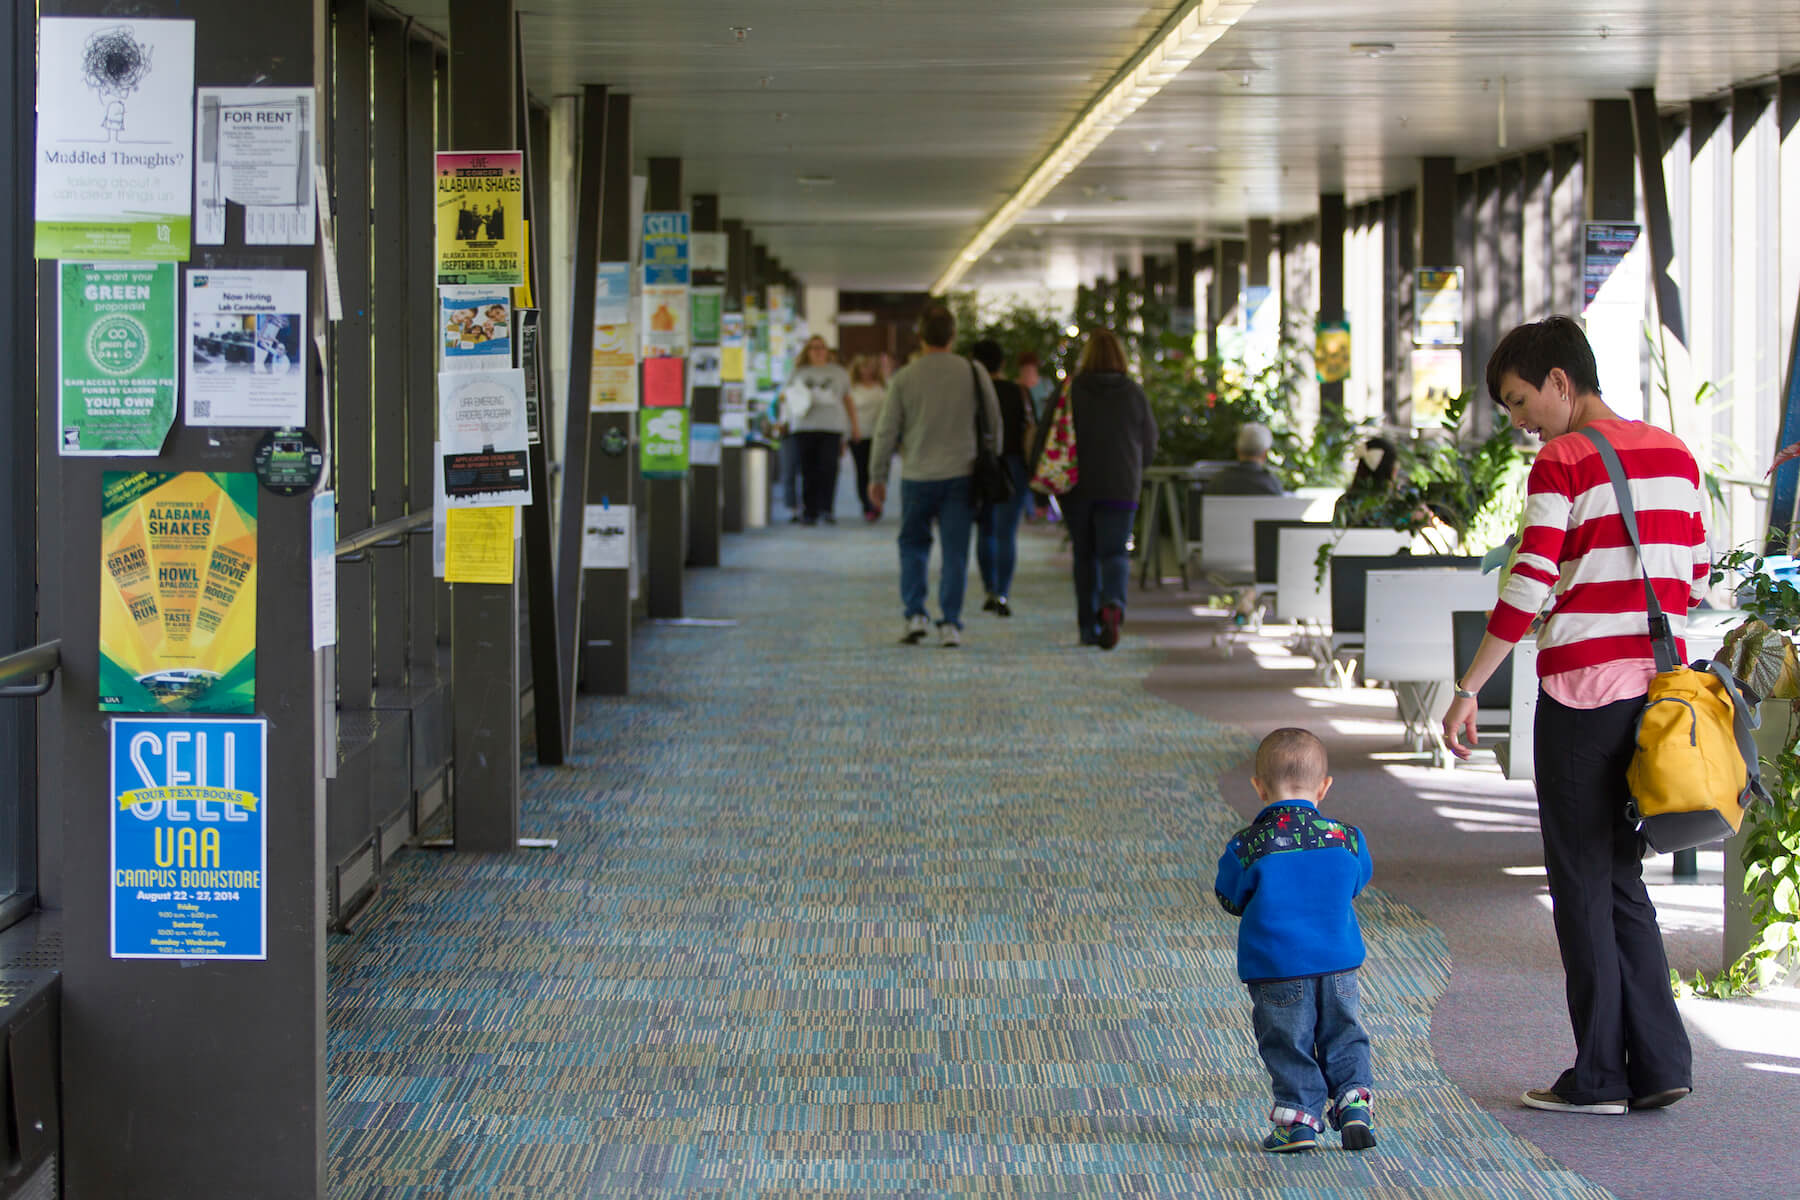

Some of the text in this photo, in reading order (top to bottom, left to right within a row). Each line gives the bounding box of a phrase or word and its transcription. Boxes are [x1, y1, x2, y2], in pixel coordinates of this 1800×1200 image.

[224, 112, 293, 123] FOR RENT
[45, 151, 184, 169] Muddled Thoughts?
[111, 176, 149, 188] about
[440, 177, 521, 192] ALABAMA SHAKES
[54, 190, 77, 201] can
[80, 188, 114, 201] clear
[498, 260, 518, 270] 2014
[103, 273, 128, 281] want
[132, 274, 153, 282] your
[85, 284, 150, 300] GREEN
[223, 292, 272, 303] Now Hiring
[218, 303, 276, 311] Lab Consultants
[85, 397, 154, 407] YOUR OWN
[149, 509, 211, 520] ALABAMA
[149, 522, 211, 536] SHAKES
[107, 548, 145, 569] GRAND
[211, 549, 252, 572] DRIVE-IN
[111, 558, 148, 577] OPENING
[159, 567, 200, 581] HOWL
[209, 559, 248, 583] MOVIE
[128, 596, 154, 609] SPIRIT
[133, 605, 158, 622] RUN
[164, 613, 191, 622] TASTE
[129, 731, 248, 822] SELL
[134, 788, 243, 802] YOUR TEXTBOOKS
[154, 826, 220, 868] UAA
[116, 869, 260, 889] CAMPUS BOOKSTORE
[136, 890, 171, 903] August
[173, 891, 187, 900] 22
[196, 891, 211, 902] 27,
[213, 891, 240, 901] 2014
[177, 903, 200, 912] Friday
[172, 920, 204, 929] Saturday
[150, 938, 179, 947] Monday
[185, 938, 227, 948] Wednesday
